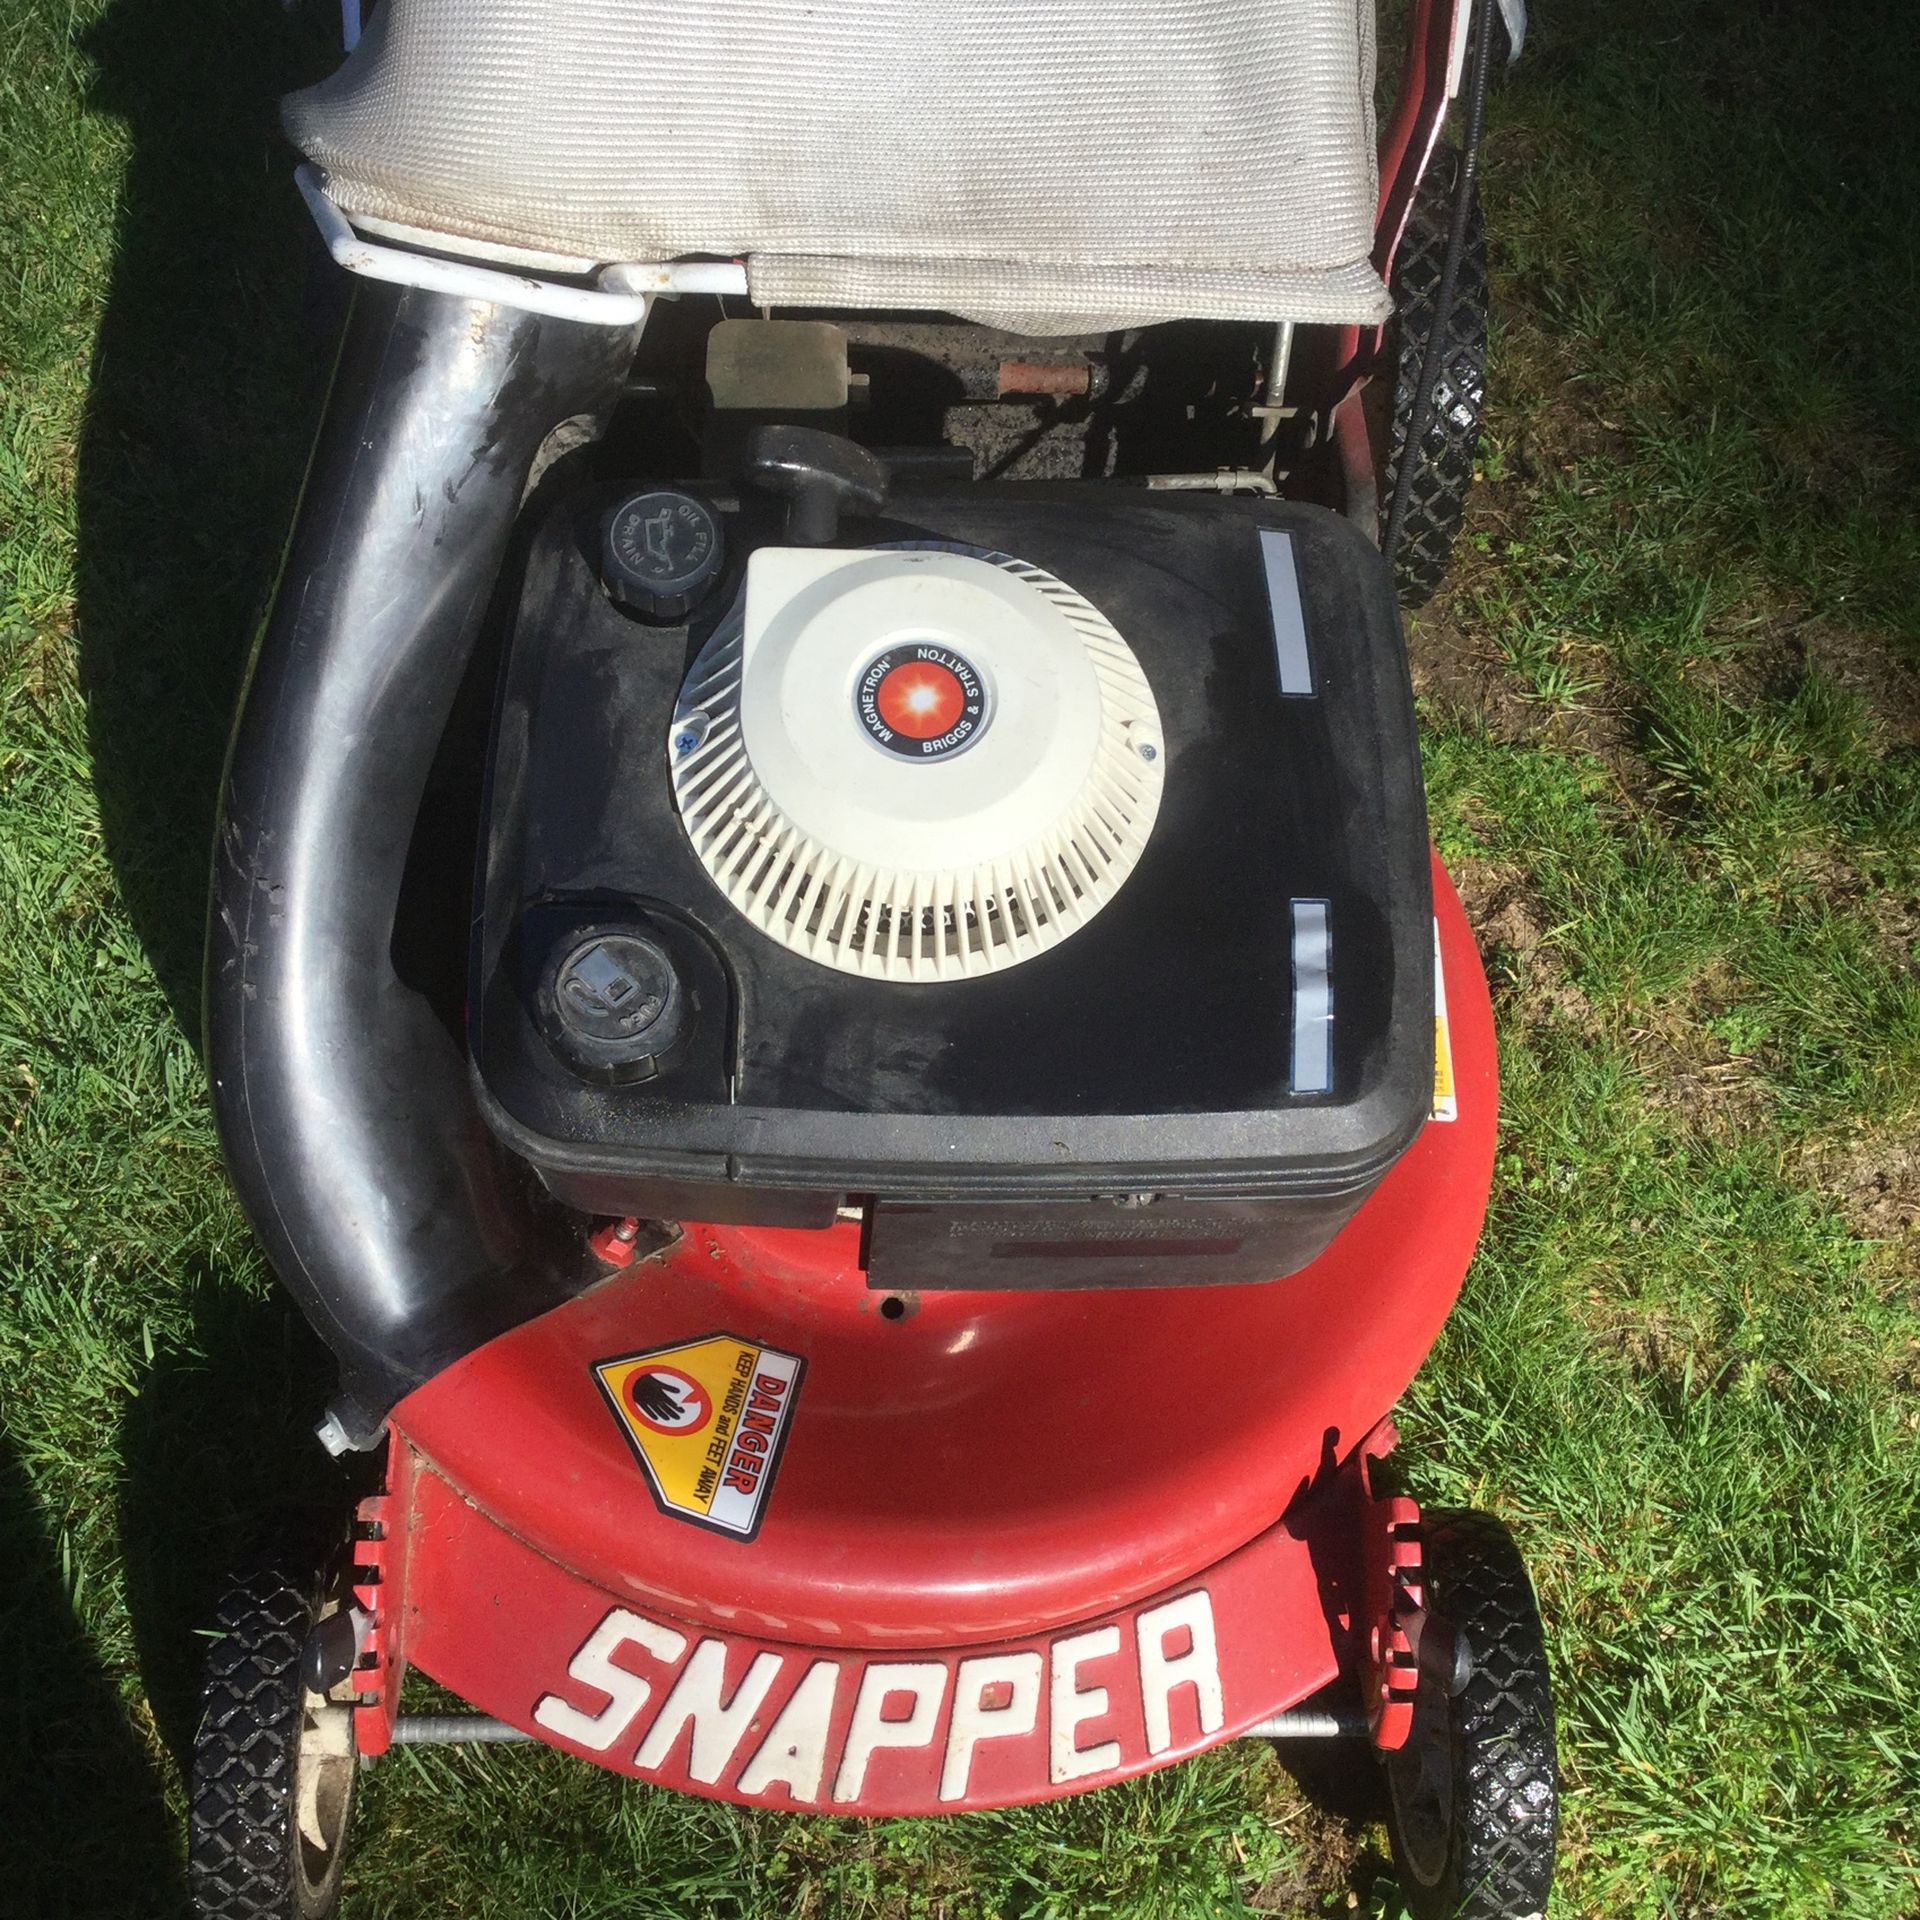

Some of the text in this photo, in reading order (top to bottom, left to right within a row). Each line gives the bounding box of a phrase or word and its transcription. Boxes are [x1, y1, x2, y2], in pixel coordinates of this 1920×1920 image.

[621, 513, 645, 565] DRAIN
[678, 505, 708, 561] OIL FILL
[862, 659, 893, 742] MAGNETRON
[917, 648, 979, 753] BRIGGS & STRATTON
[618, 994, 662, 1034] FUEL
[692, 1351, 756, 1504] KEEP HANDS and FEET AWAY
[722, 1373, 787, 1496] DANGER
[531, 1587, 1226, 1804] SNAPPER
